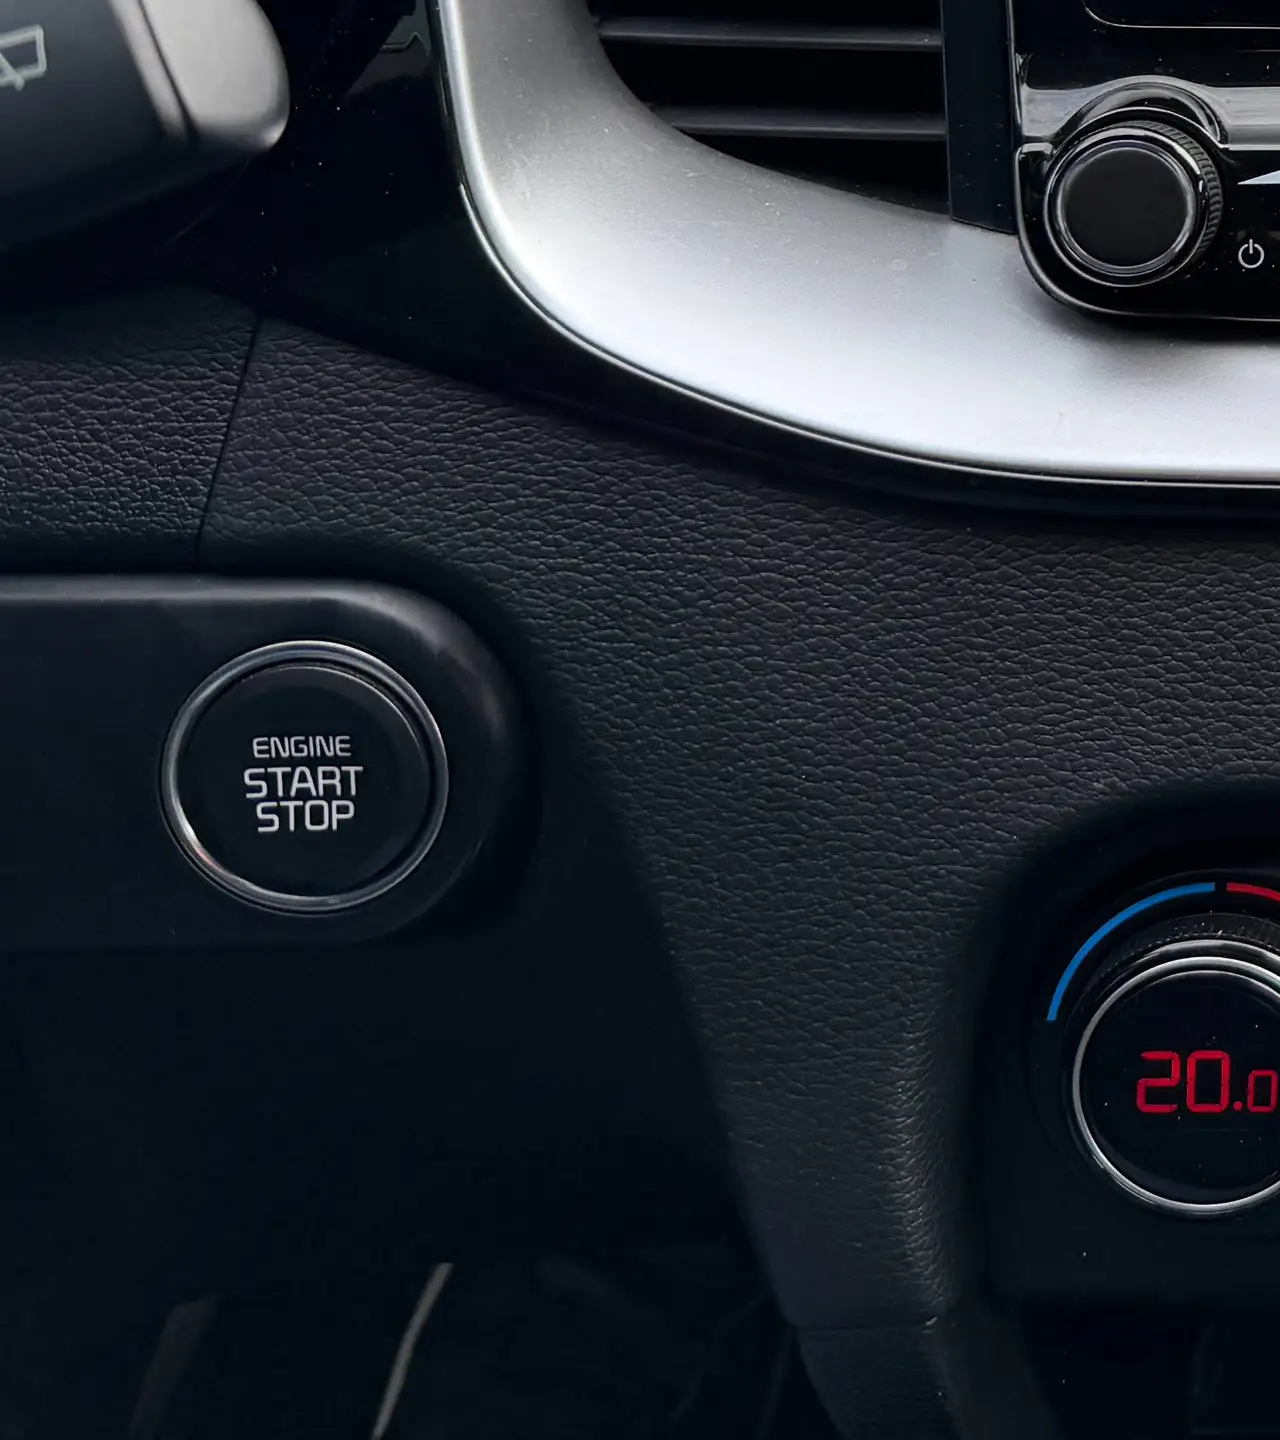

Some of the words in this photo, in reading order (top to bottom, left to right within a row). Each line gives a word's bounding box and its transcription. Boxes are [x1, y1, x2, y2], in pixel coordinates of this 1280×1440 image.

[252, 735, 352, 759] ENGINE
[243, 765, 364, 799] START
[256, 799, 355, 833] STOP
[1135, 1049, 1279, 1114] 20.0
